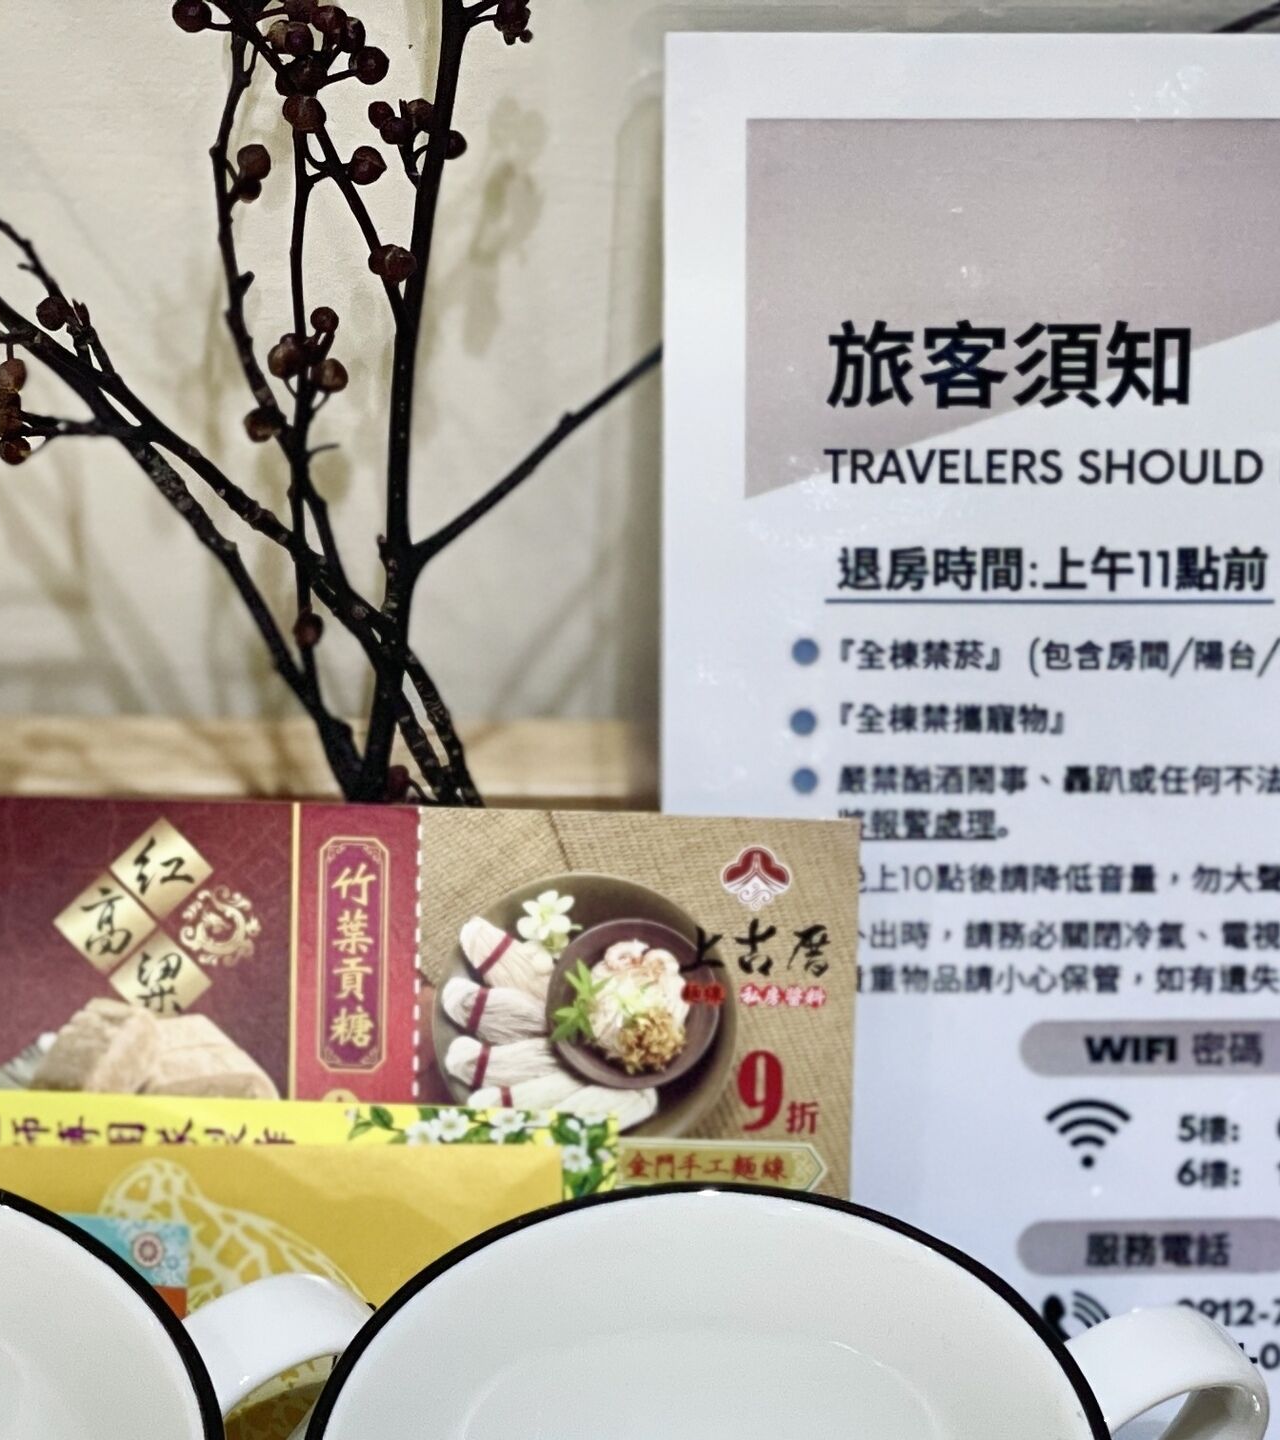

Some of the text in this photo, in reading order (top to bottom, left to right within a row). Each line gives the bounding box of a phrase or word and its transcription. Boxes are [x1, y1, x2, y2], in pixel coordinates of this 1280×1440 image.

[827, 319, 1191, 408] 旅客須知
[824, 447, 1064, 486] TRAVELERS
[1079, 448, 1264, 486] SHOULD
[838, 546, 1268, 594] 退房時間:上午11點前
[329, 863, 376, 1047] 竹葉貢糖
[1085, 1032, 1264, 1067] WIFI 密碼
[737, 1049, 820, 1135] 9折
[1085, 1231, 1232, 1268] 服務電話
